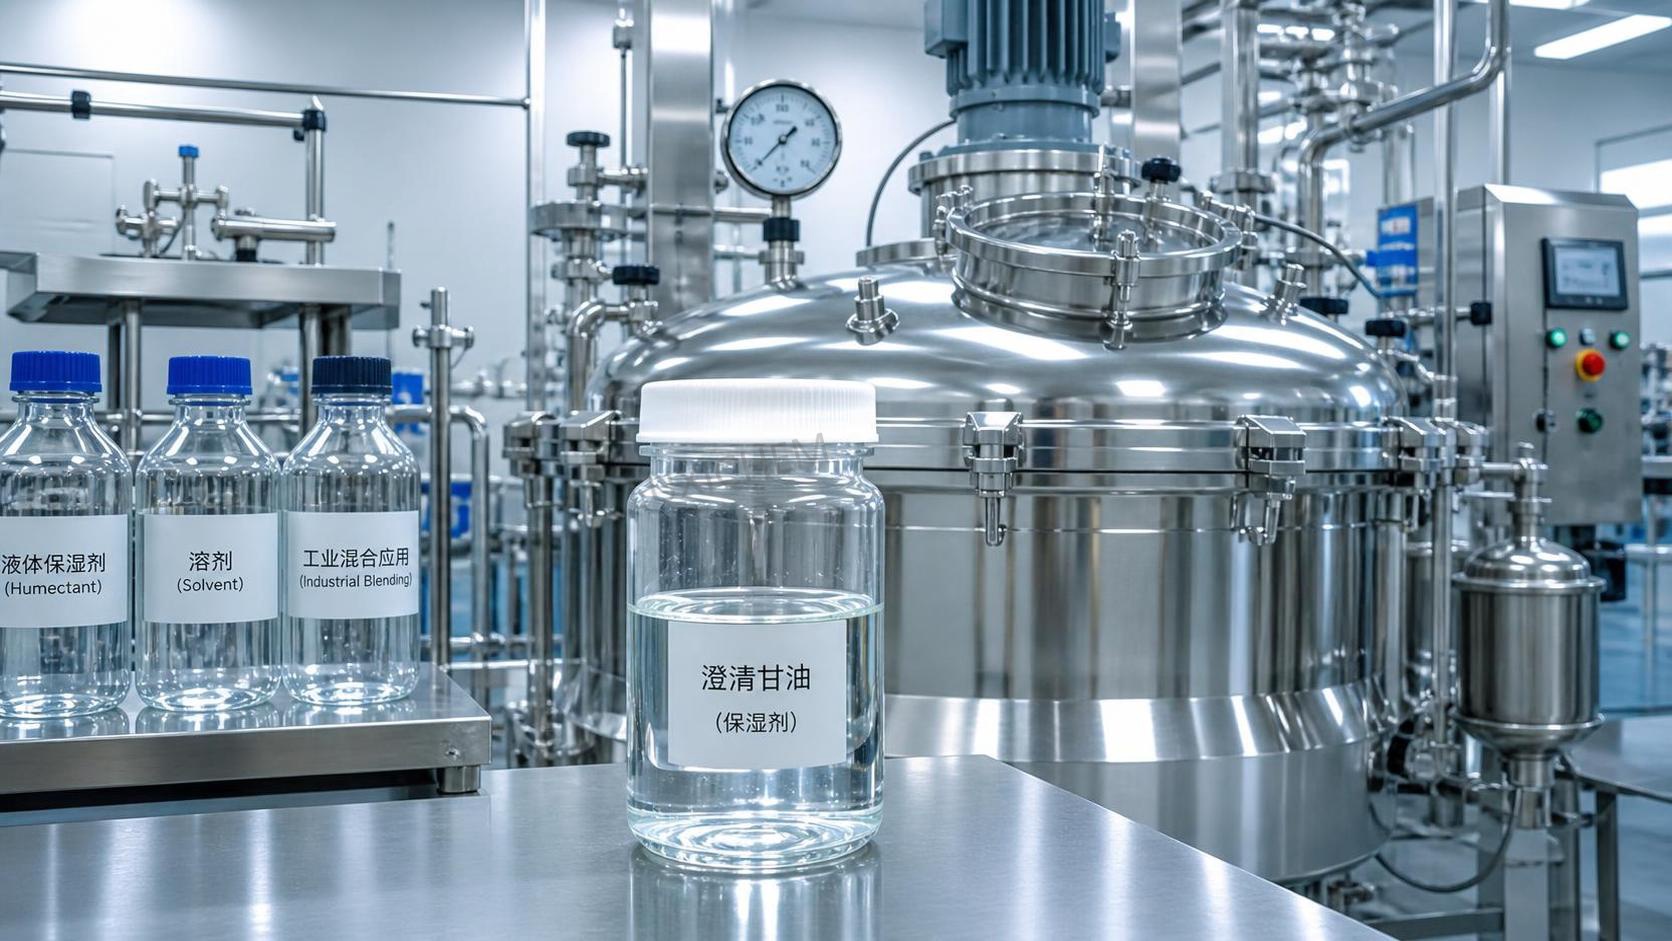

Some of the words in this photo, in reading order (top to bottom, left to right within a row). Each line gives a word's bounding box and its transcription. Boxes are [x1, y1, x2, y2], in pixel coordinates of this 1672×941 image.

[1, 552, 106, 575] 液体保湿剂
[189, 550, 233, 572] 溶剂
[303, 547, 409, 569] 工业混合应用
[4, 579, 102, 597] (Humectant)
[177, 576, 244, 594] (Solvent)
[299, 574, 360, 589] (Industrial
[364, 572, 413, 588] Blending)
[701, 663, 811, 692] 澄清甘油
